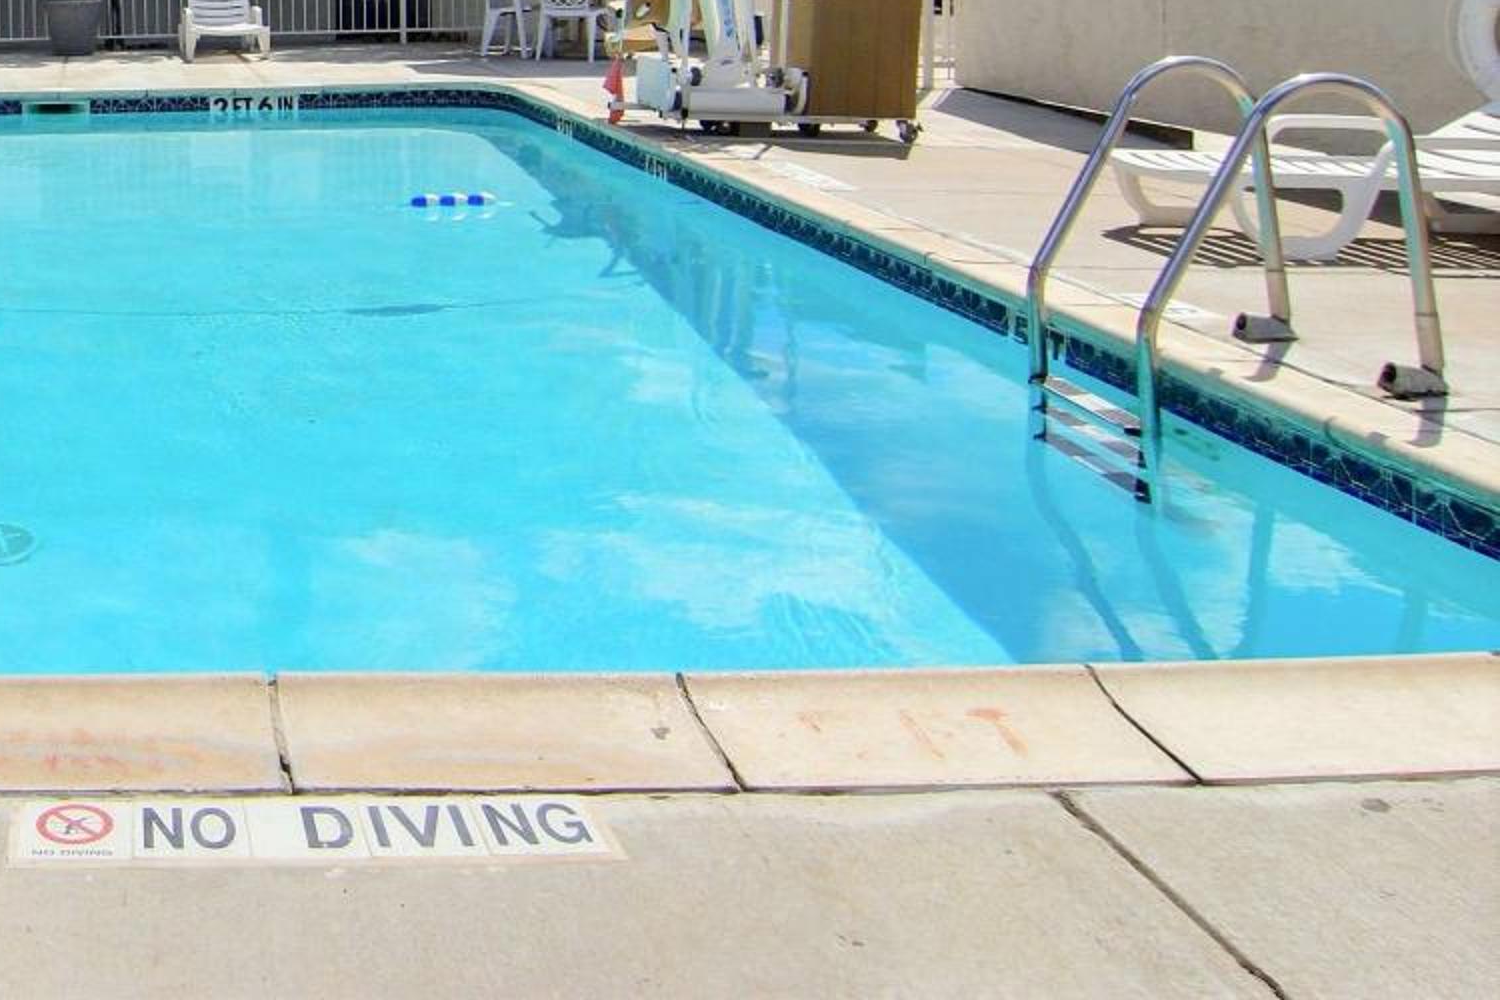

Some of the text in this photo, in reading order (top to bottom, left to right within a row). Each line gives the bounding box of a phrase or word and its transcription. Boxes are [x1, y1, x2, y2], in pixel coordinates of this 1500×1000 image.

[232, 97, 253, 111] FT
[258, 96, 273, 112] 6
[277, 96, 293, 111] IN
[142, 803, 594, 850] NO DIVING
